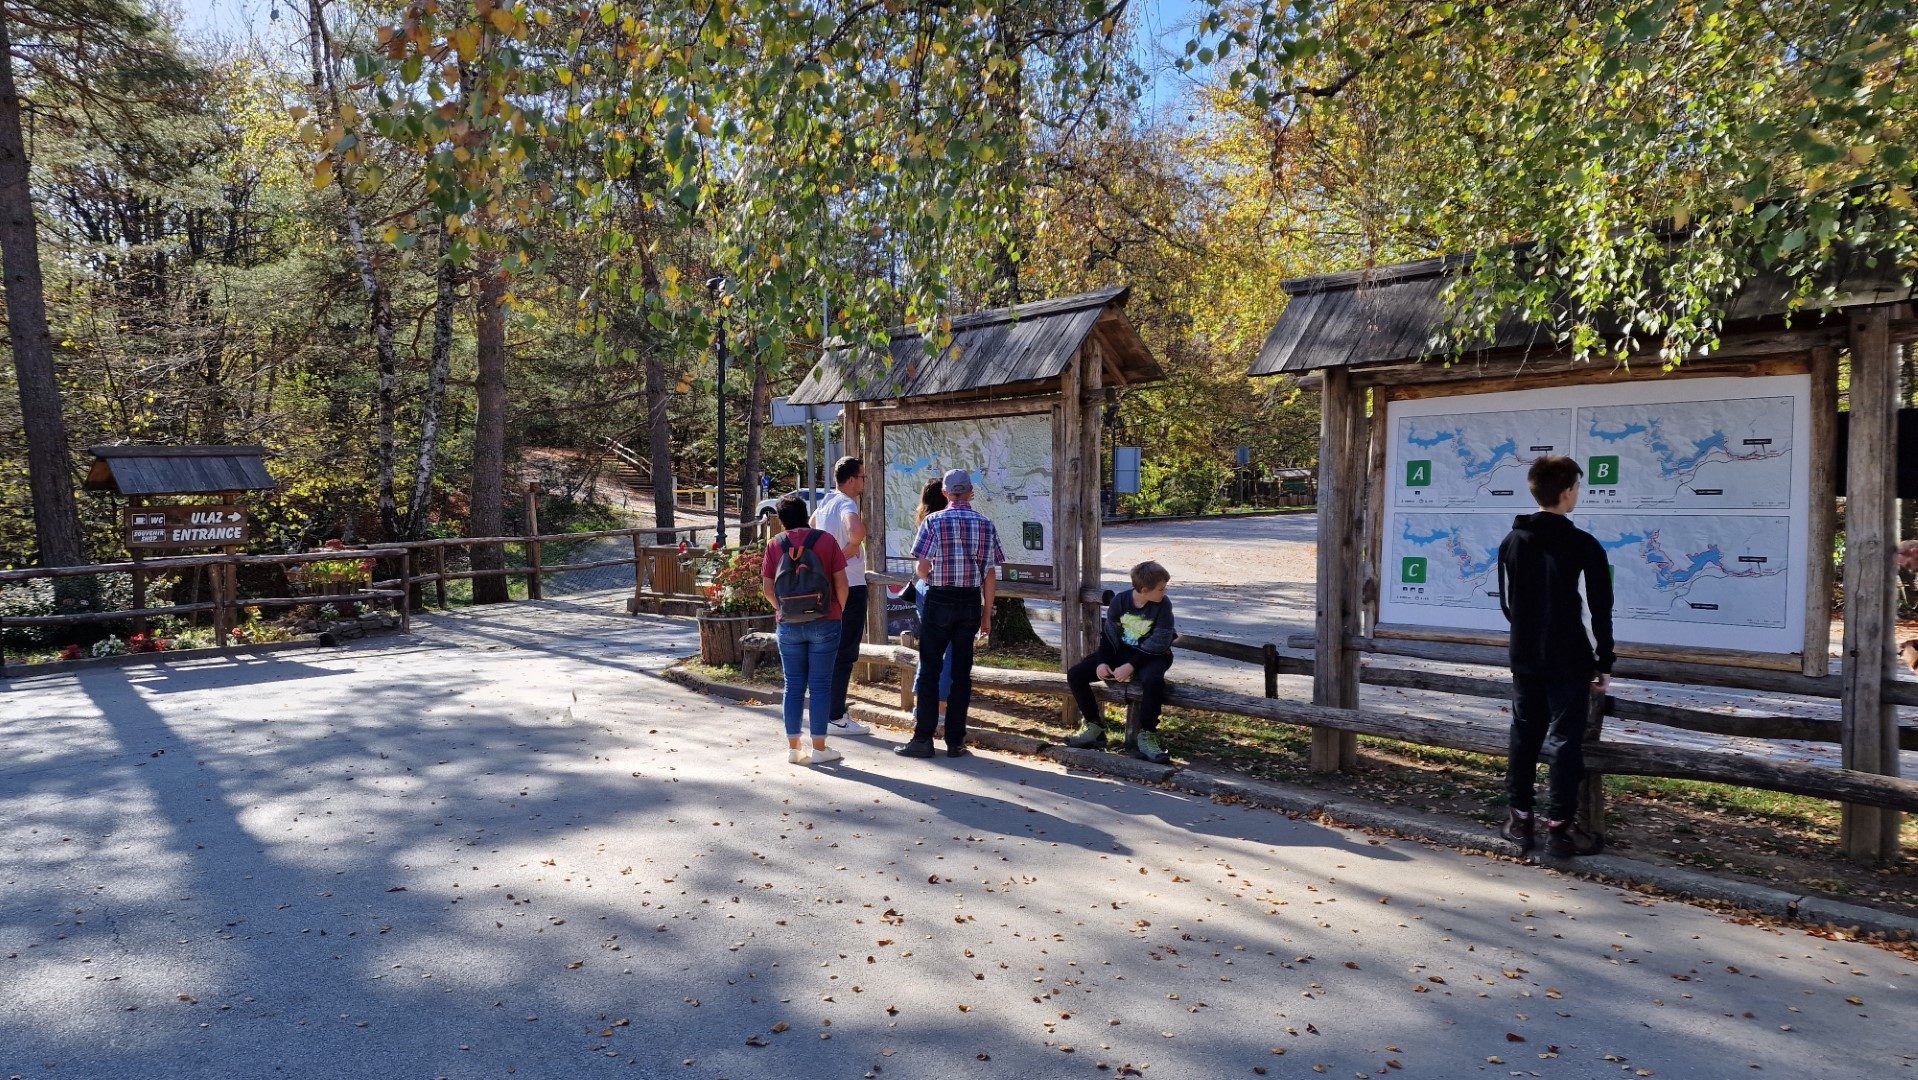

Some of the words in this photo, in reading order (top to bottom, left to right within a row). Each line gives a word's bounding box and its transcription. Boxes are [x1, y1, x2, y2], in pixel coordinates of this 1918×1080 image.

[1412, 466, 1424, 481] A
[1597, 463, 1610, 478] B
[150, 516, 164, 524] WC
[190, 511, 223, 524] ULAZ
[172, 527, 242, 541] ENTRANCE
[1408, 563, 1420, 577] C
